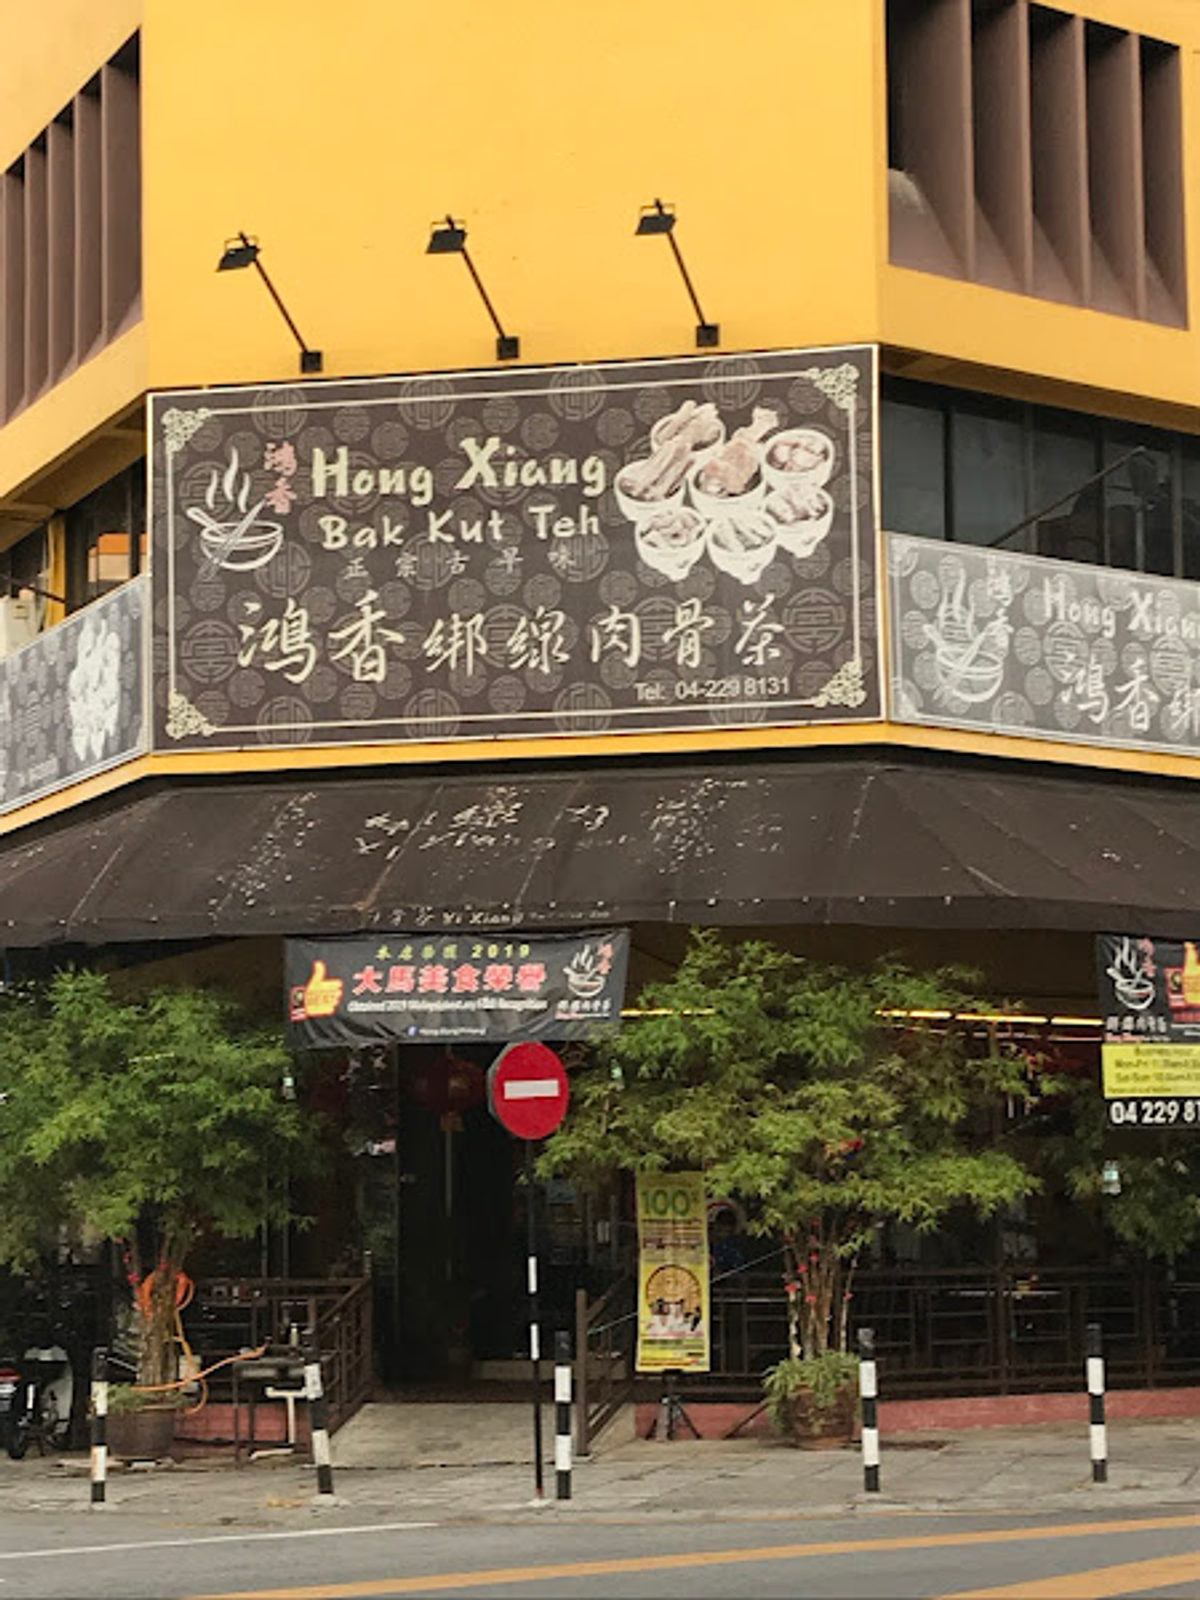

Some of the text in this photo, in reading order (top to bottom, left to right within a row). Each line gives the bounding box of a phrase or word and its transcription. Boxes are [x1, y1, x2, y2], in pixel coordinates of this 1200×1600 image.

[311, 437, 606, 505] Hong Xiang
[317, 504, 600, 549] Bak Kut Teh
[1044, 576, 1116, 639] Hong
[674, 679, 741, 700] 04-229
[743, 676, 790, 696] 8131
[471, 943, 530, 960] 2019
[1110, 1101, 1137, 1124] 04
[1141, 1101, 1180, 1124] 229
[643, 1188, 690, 1216] 100
